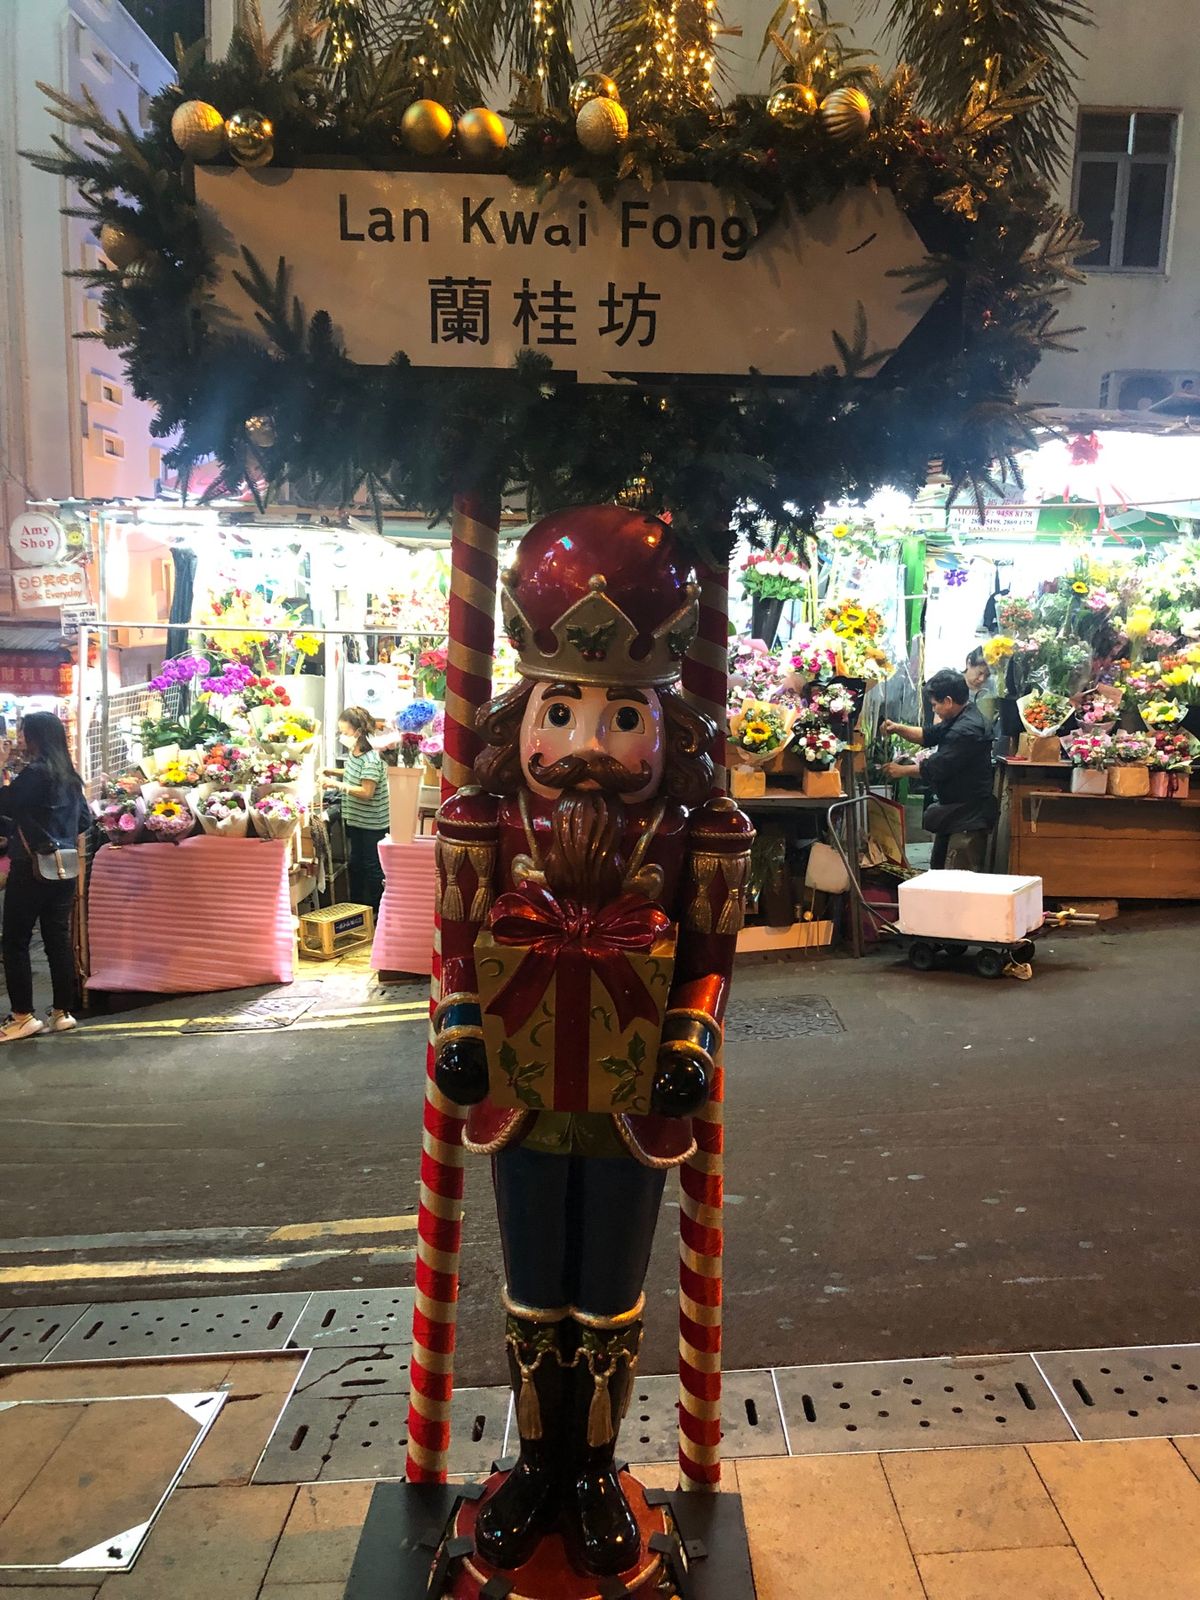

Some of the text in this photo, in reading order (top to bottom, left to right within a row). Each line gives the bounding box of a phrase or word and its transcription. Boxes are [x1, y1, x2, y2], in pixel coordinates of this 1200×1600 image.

[339, 194, 748, 261] Lan Kwai Fong
[428, 276, 661, 347] 蘭桂坊
[22, 525, 50, 536] Amy
[20, 538, 55, 549] Shop
[45, 587, 82, 600] Everyday
